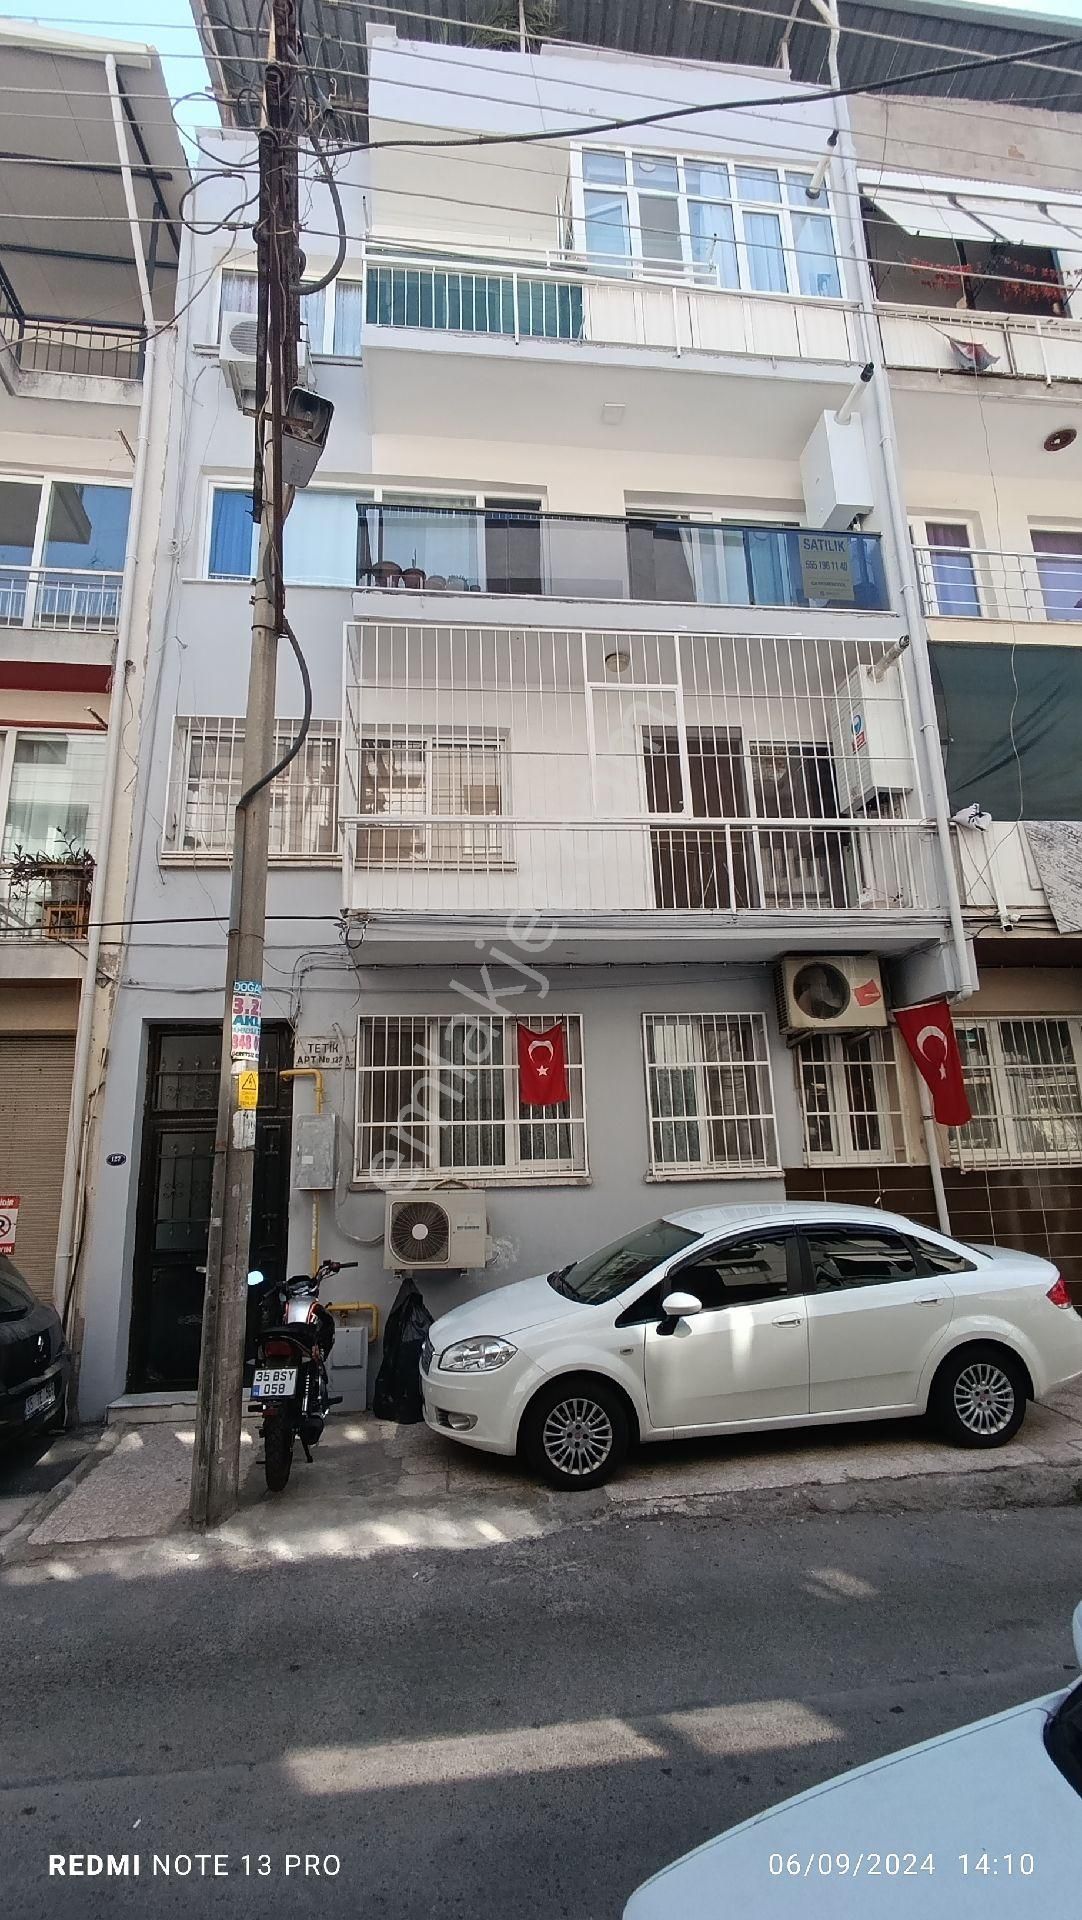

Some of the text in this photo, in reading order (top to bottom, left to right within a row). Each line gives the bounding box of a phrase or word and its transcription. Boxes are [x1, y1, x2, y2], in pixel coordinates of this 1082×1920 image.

[803, 538, 845, 552] SATILIK
[297, 1055, 316, 1064] APT
[256, 1370, 295, 1382] 35 BSY
[264, 1383, 286, 1395] 058
